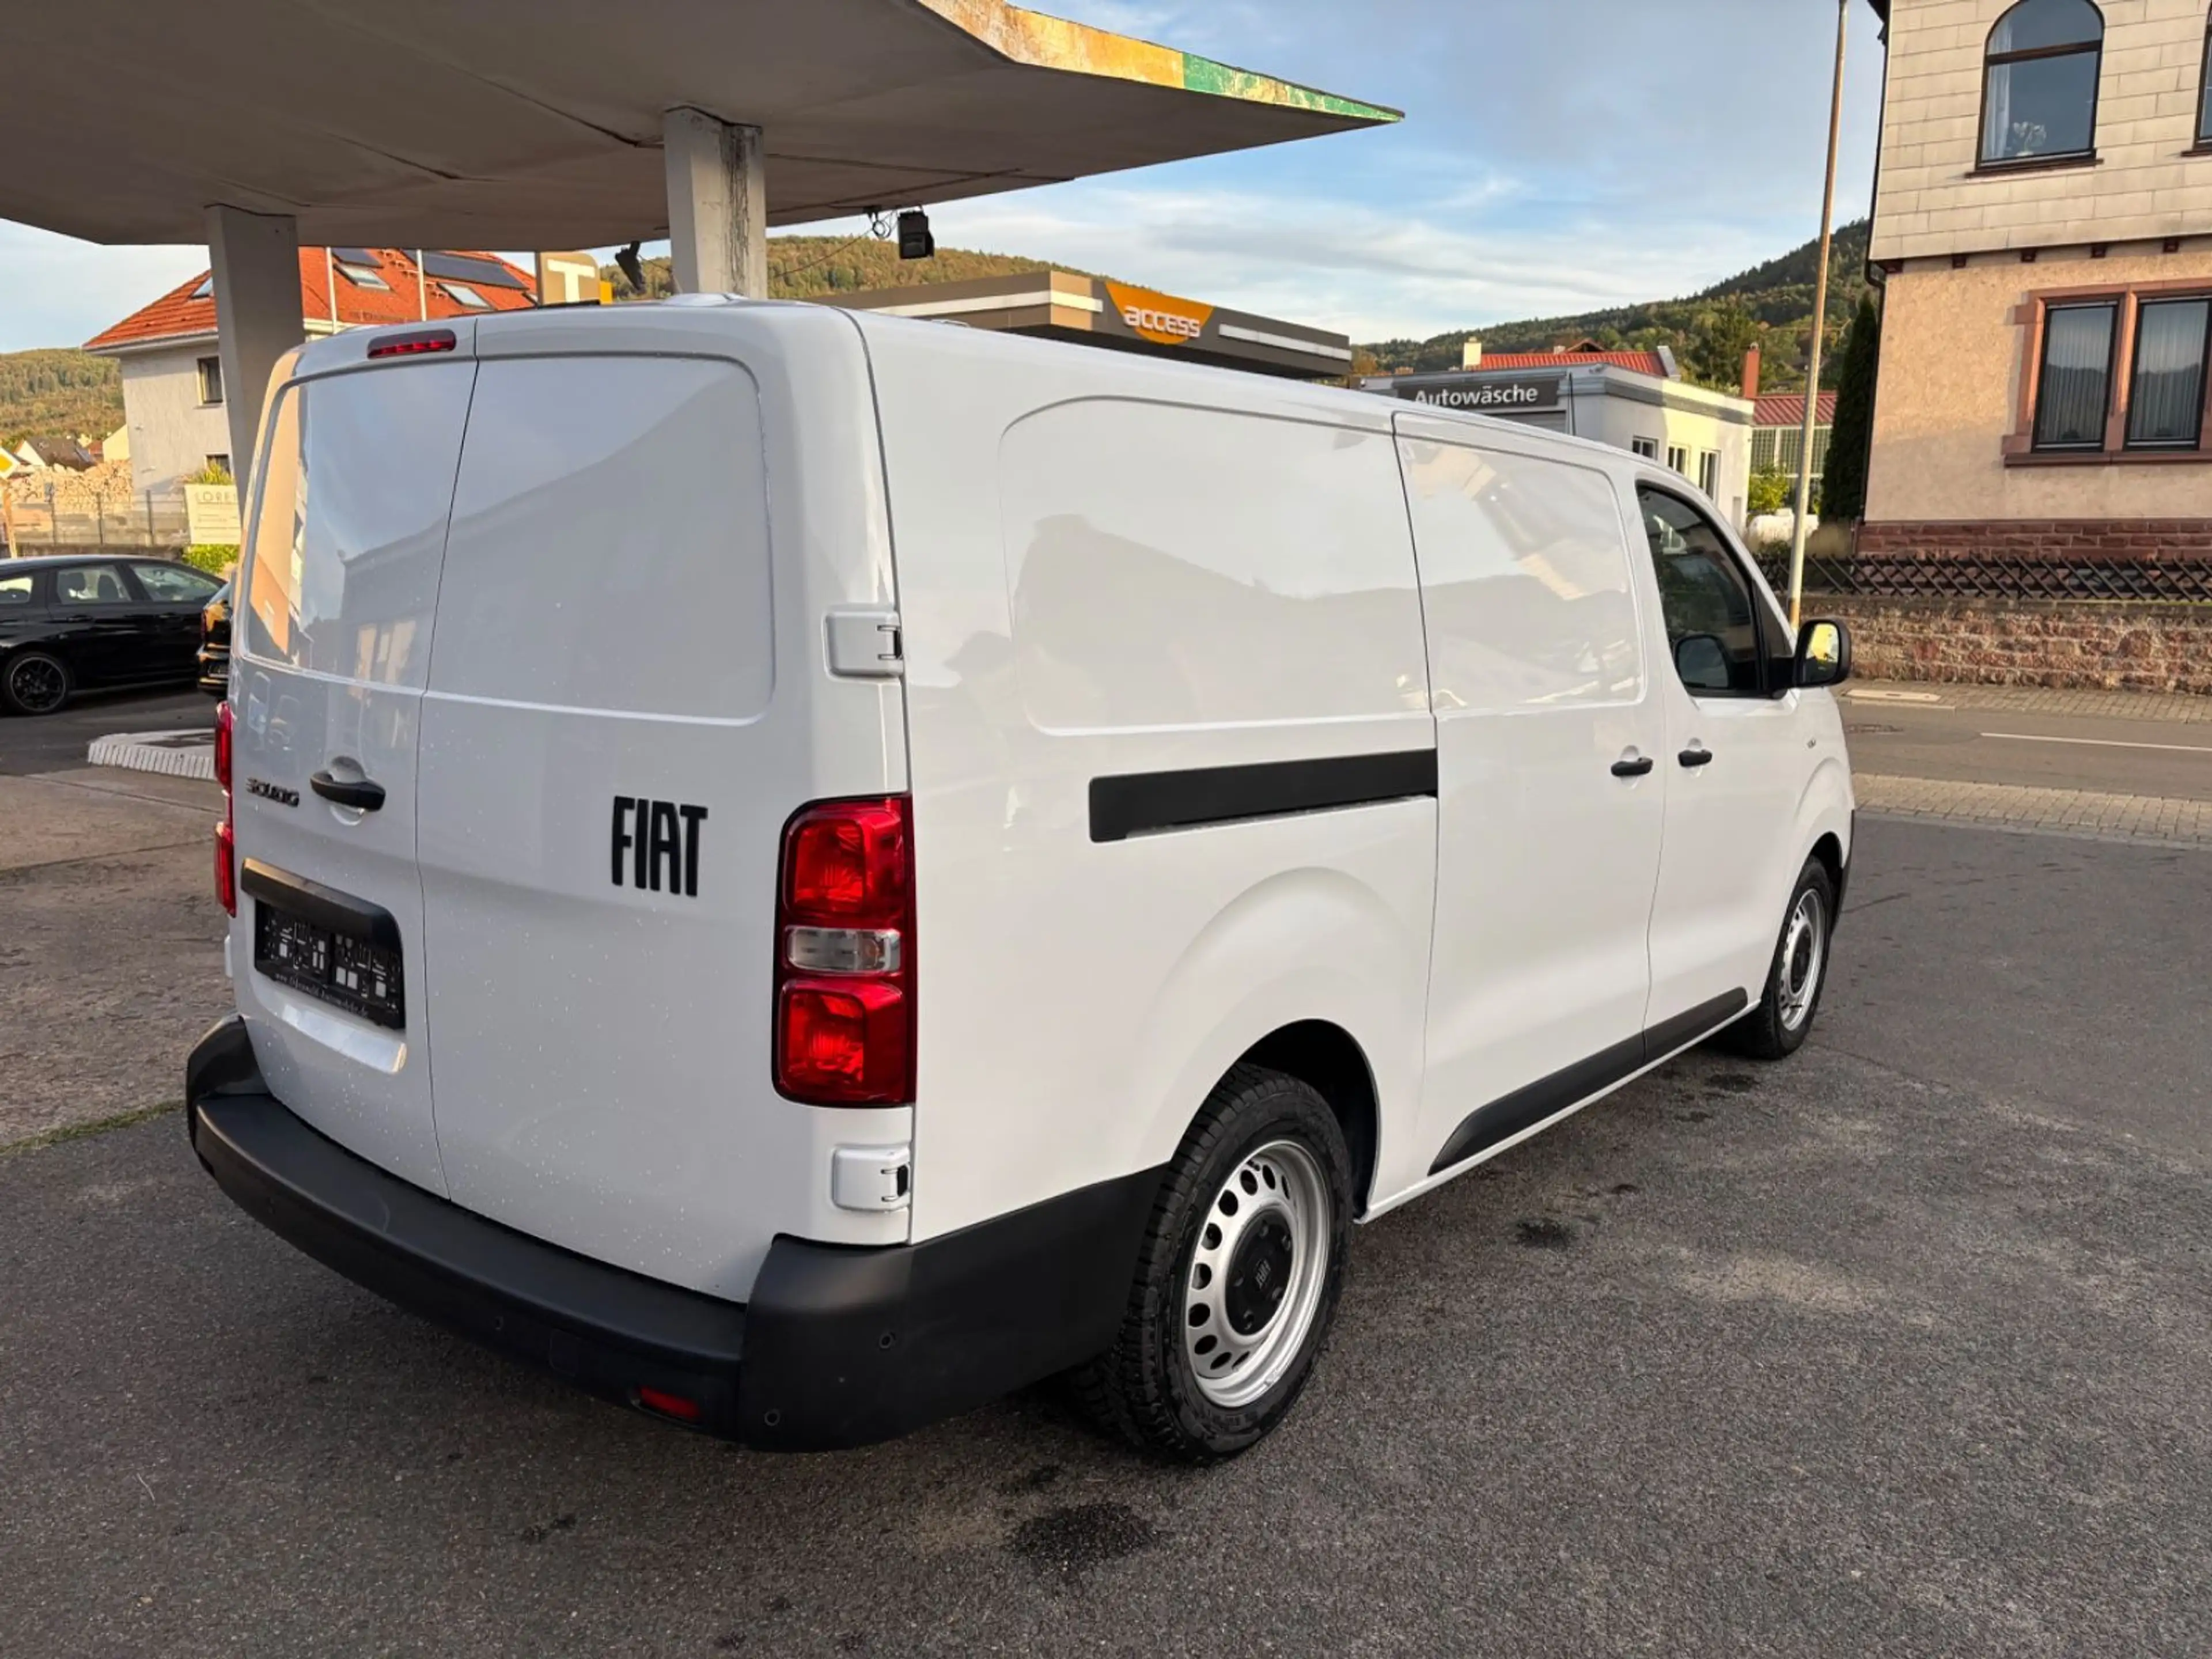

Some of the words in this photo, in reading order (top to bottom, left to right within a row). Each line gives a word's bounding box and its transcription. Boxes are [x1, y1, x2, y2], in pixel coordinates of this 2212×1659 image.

[1124, 305, 1200, 338] access
[1415, 384, 1539, 406] Autowäsche
[611, 795, 708, 898] FIAT
